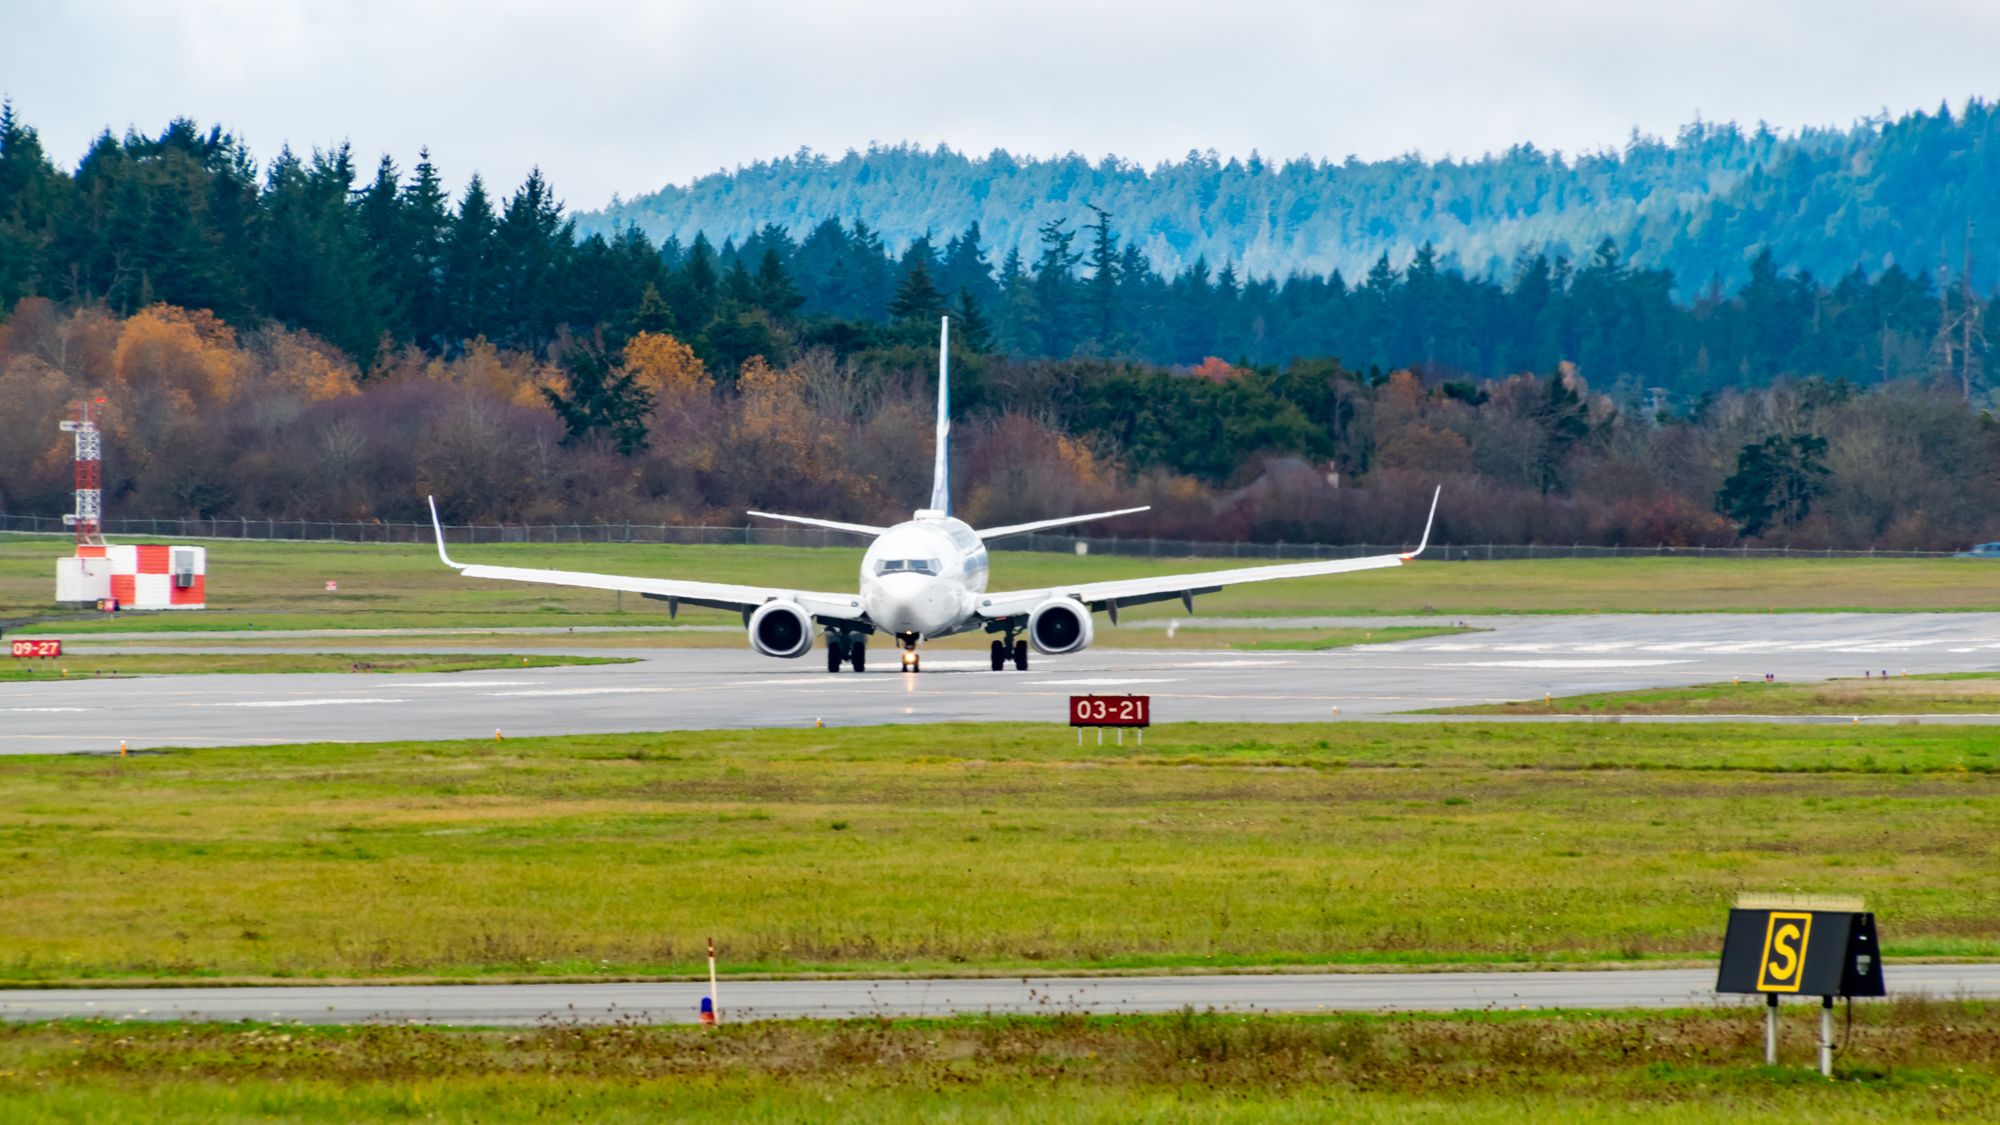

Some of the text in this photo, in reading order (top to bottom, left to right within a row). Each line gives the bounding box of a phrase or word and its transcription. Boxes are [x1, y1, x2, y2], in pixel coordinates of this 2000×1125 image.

[13, 642, 58, 656] 09-27
[1076, 700, 1143, 720] 03-21
[1768, 923, 1801, 981] S
